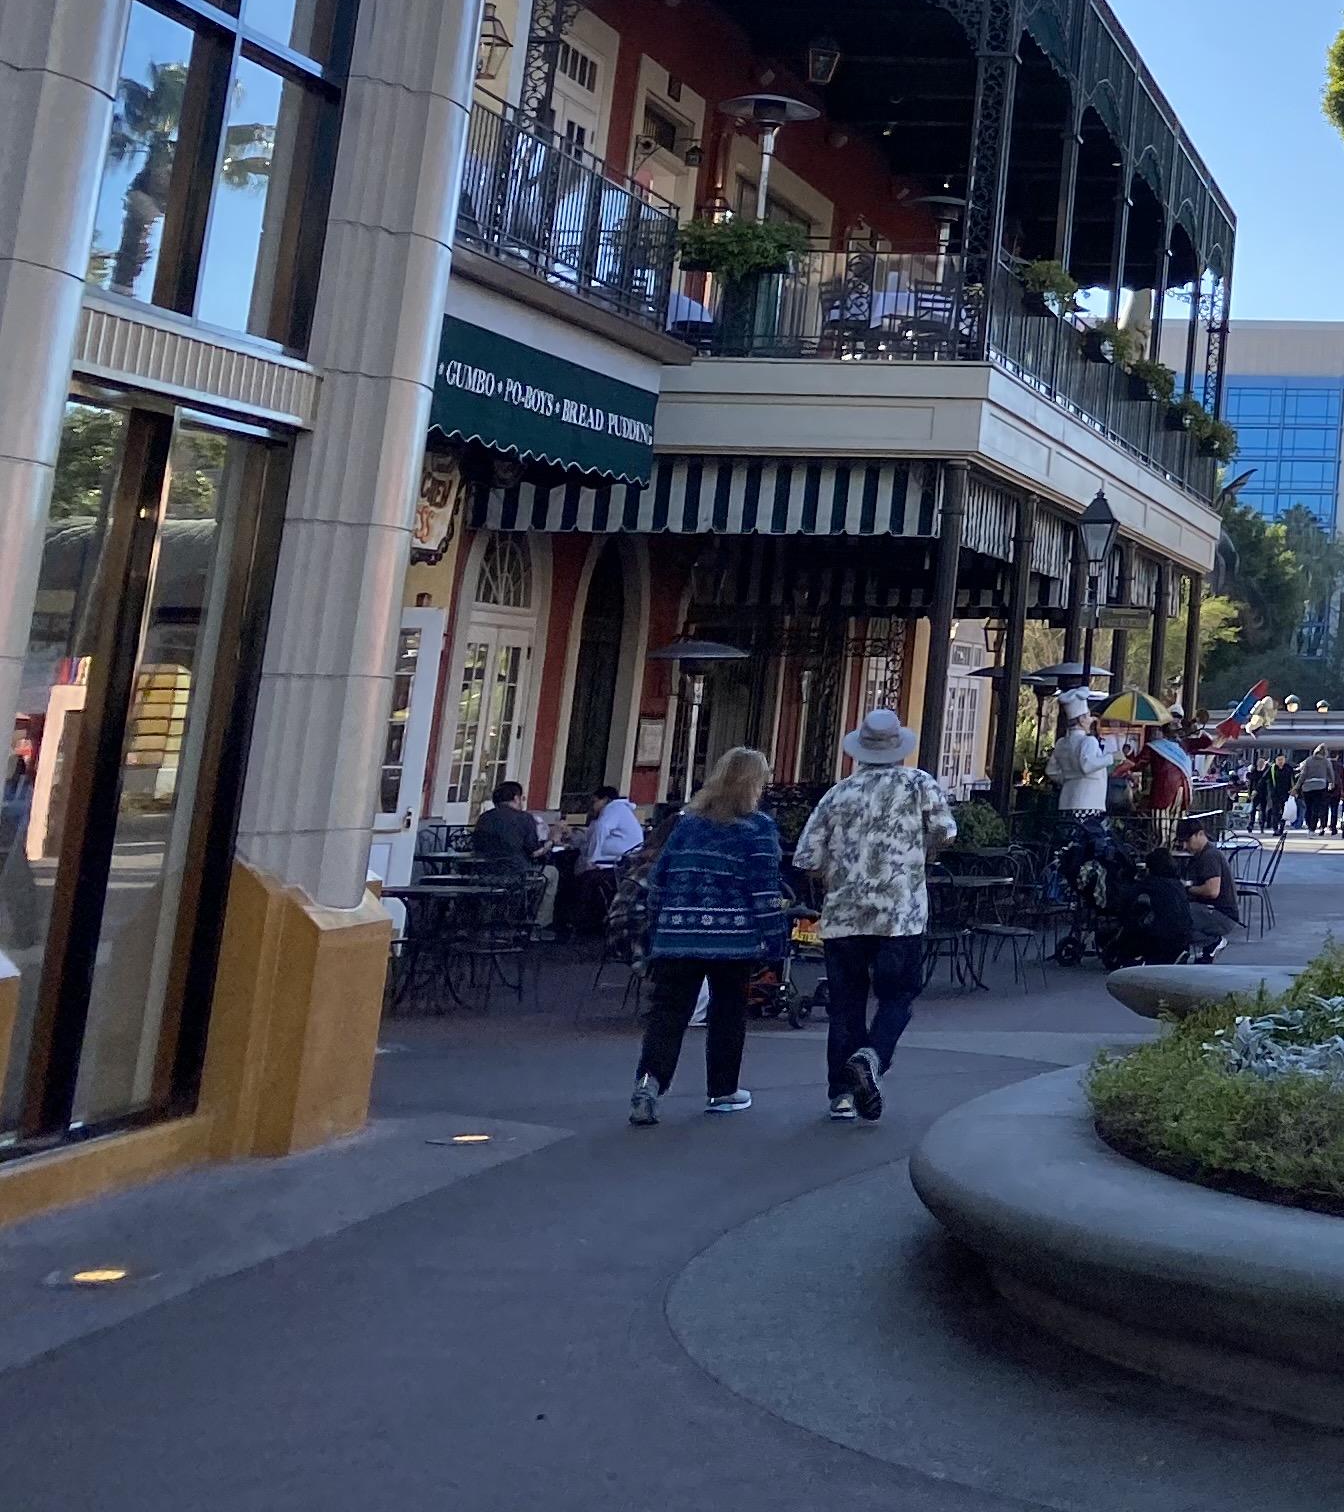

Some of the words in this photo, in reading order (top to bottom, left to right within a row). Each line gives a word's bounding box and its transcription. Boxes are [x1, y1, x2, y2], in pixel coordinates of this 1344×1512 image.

[446, 360, 495, 397] GUMBO
[504, 378, 554, 416] PO-BOYS
[561, 399, 605, 431] BREAD
[608, 413, 653, 446] PUDDING
